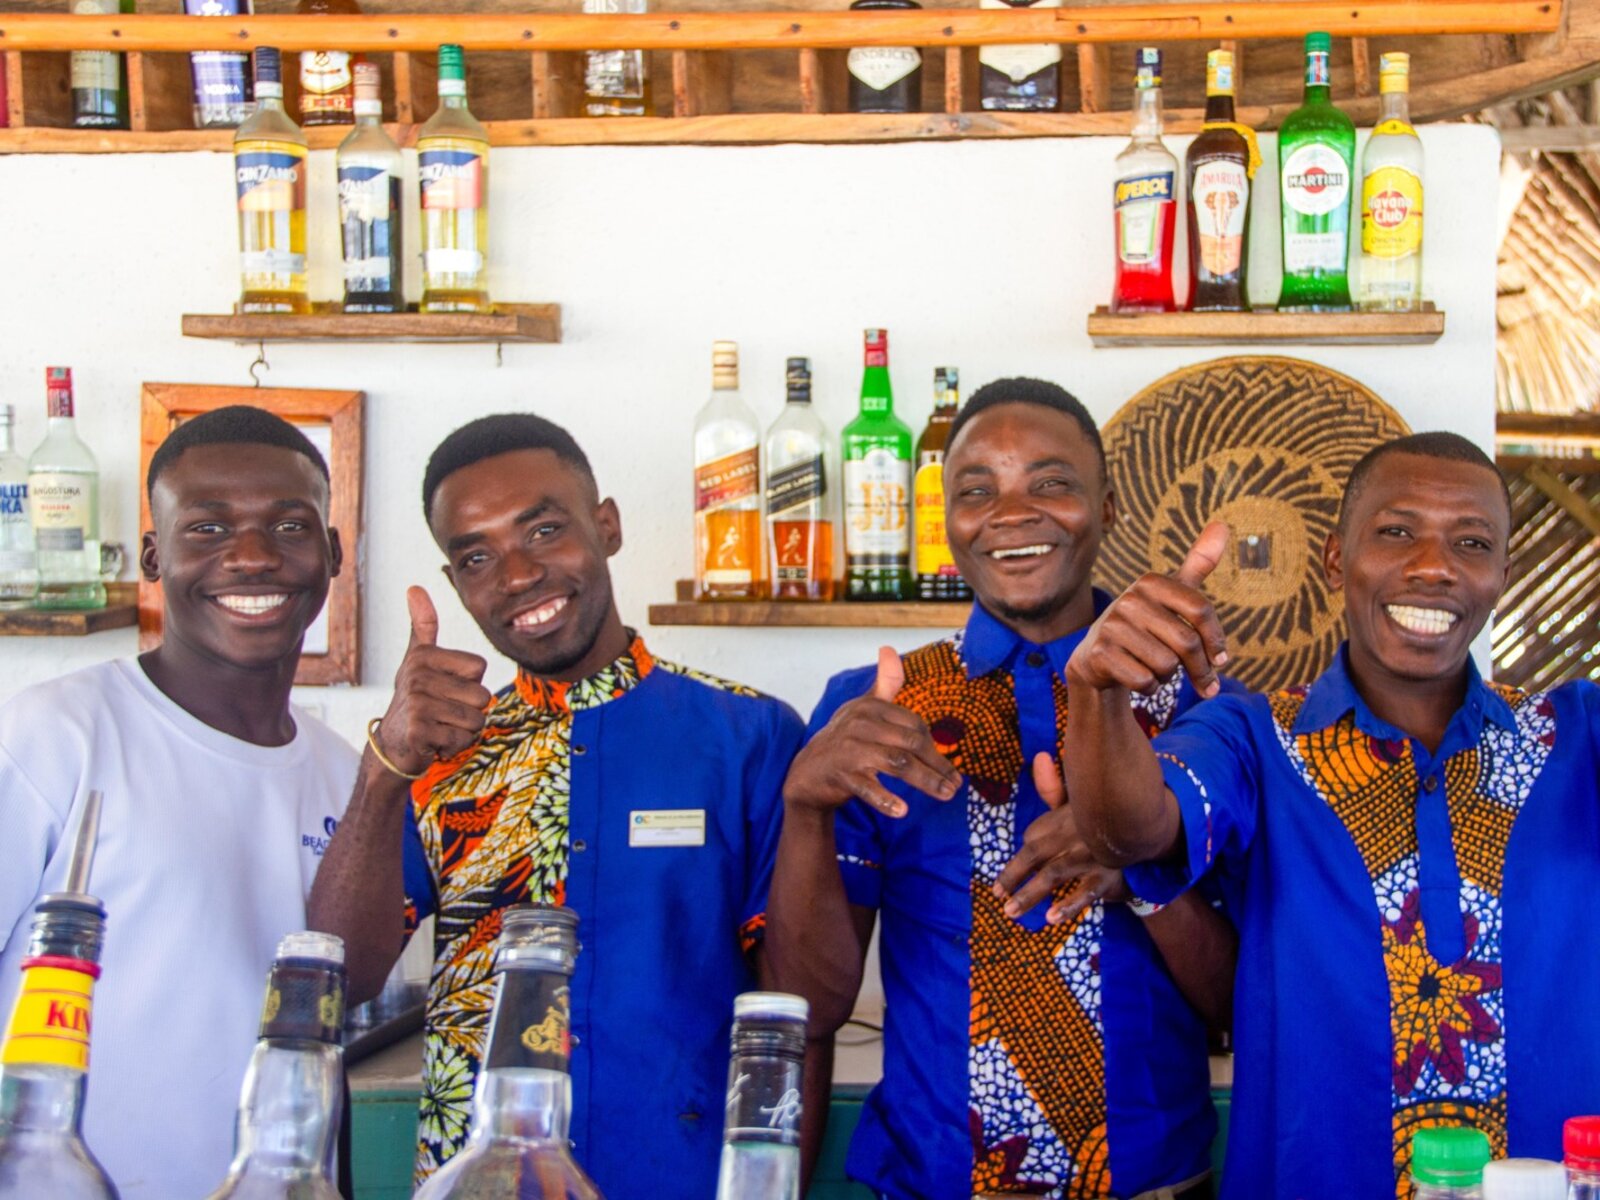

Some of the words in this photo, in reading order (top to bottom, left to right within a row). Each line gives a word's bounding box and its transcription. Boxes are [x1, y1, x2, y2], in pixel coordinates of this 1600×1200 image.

[237, 164, 298, 183] CINZANO
[1287, 173, 1343, 188] MARTINI
[1114, 178, 1169, 206] APEROL
[1375, 208, 1404, 223] Club
[698, 475, 722, 490] RED
[722, 462, 757, 482] LABEL
[0, 484, 28, 499] LUT
